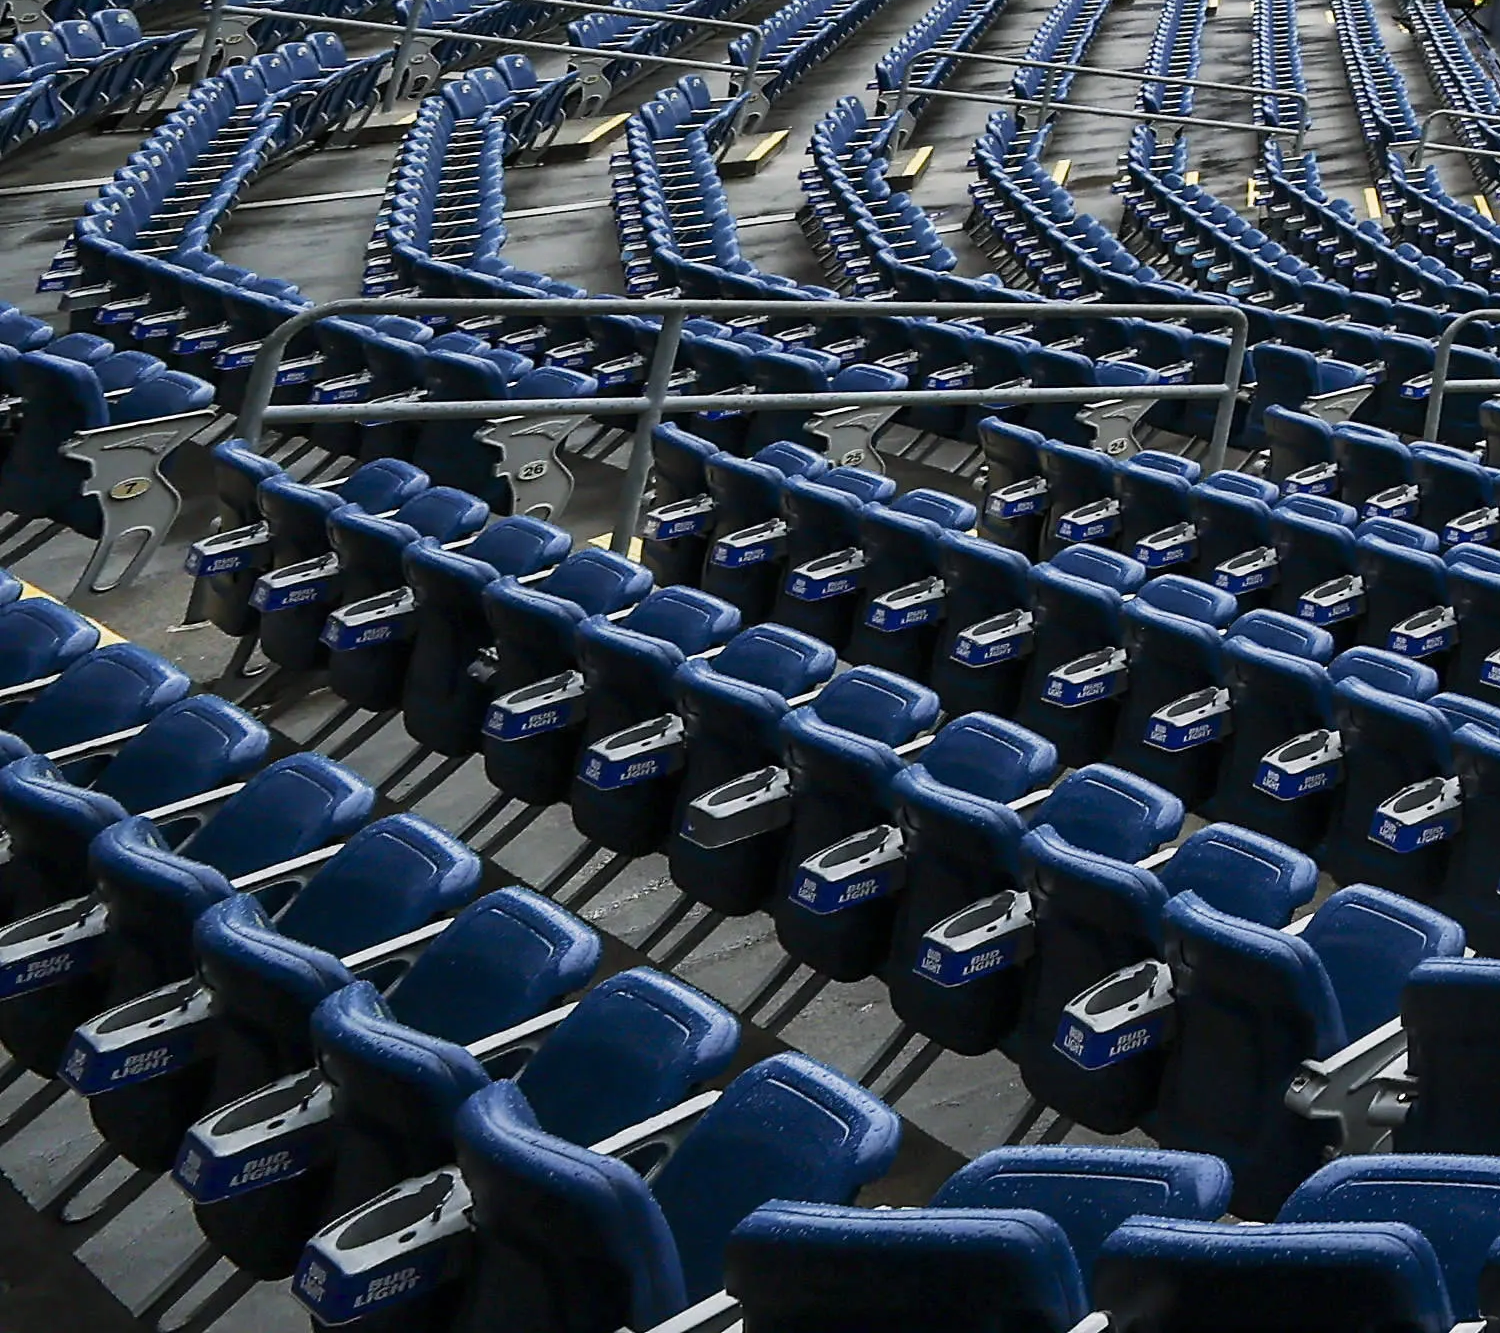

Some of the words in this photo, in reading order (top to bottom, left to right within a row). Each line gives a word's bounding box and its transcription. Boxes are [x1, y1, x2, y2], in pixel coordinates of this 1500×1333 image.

[1110, 439, 1125, 452] 24
[845, 452, 862, 463] 25
[522, 463, 544, 478] 26
[124, 482, 137, 494] 7
[839, 885, 878, 904] LIGHT
[847, 879, 875, 893] BUD
[30, 954, 70, 972] BUD
[962, 954, 1004, 976] LIGHT
[970, 949, 1000, 965] BUD
[16, 960, 73, 984] LIGHT
[1116, 1029, 1148, 1044] BUD
[1109, 1035, 1151, 1057] LIGHT
[126, 1048, 168, 1064] BUD
[110, 1054, 173, 1080] LIGHT
[244, 1151, 289, 1171] BUD
[229, 1157, 291, 1187] LIGHT
[371, 1267, 416, 1286] BUD
[354, 1273, 420, 1307] LIGHT
